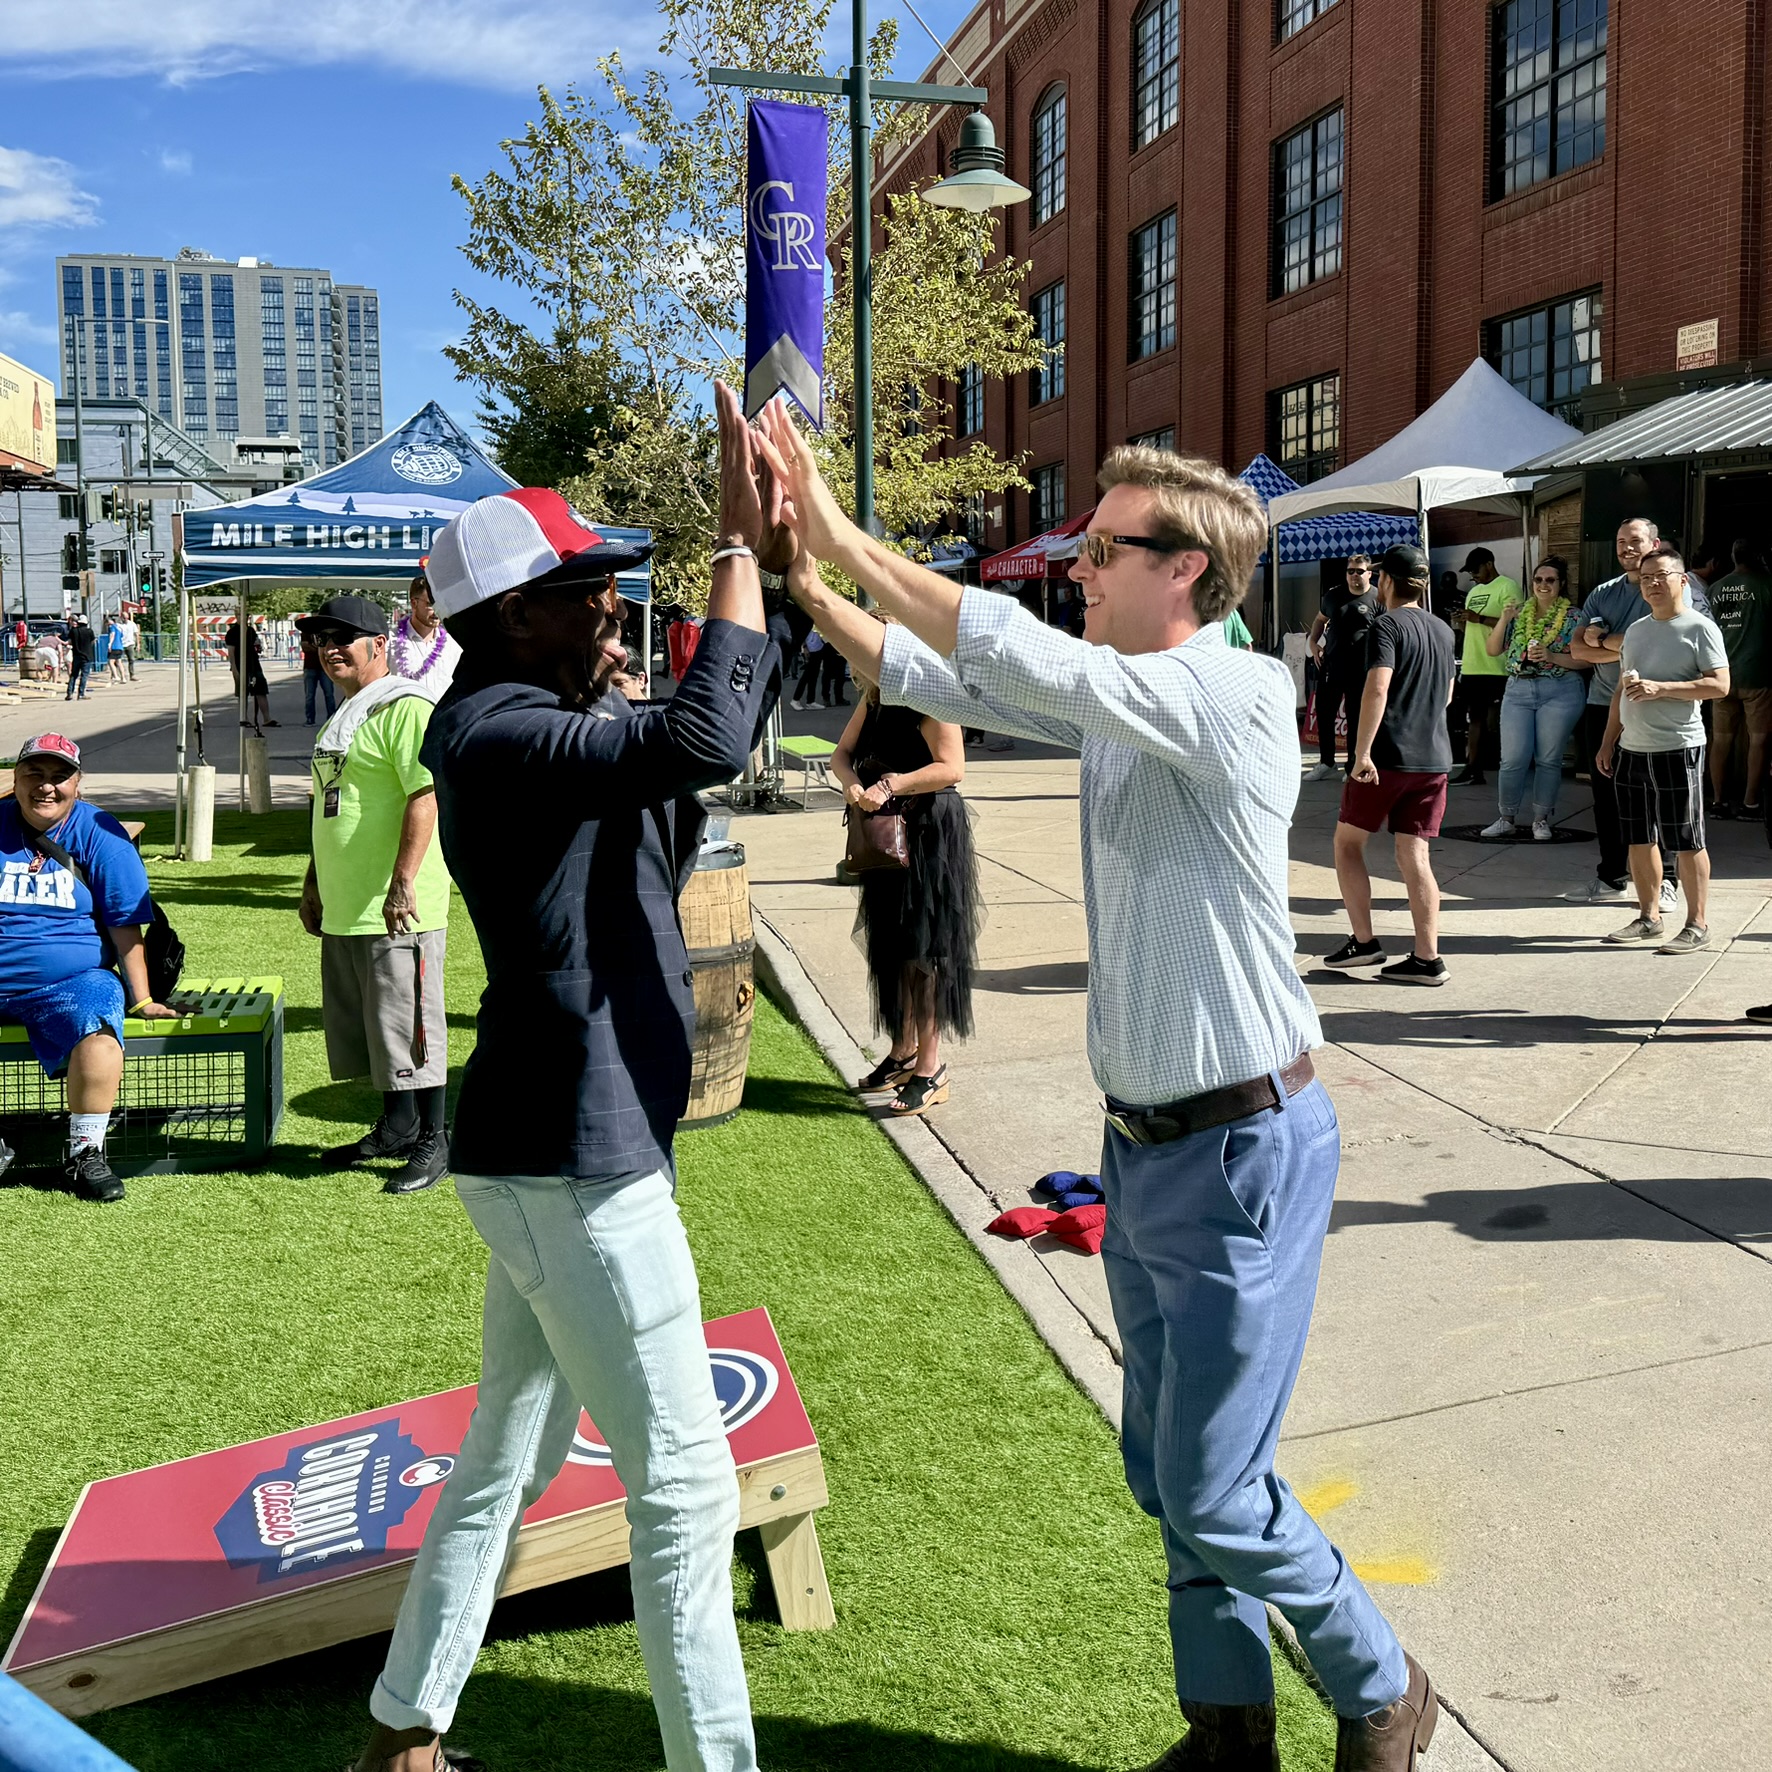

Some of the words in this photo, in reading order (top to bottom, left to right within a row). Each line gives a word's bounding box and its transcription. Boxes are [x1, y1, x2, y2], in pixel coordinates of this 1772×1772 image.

[1680, 330, 1687, 338] NO
[1691, 340, 1714, 352] PROPERTY
[1679, 353, 1704, 365] VIOLATORS
[1704, 350, 1716, 360] WILL
[211, 522, 295, 547] MILE
[306, 525, 391, 549] HIGH
[998, 558, 1038, 577] CHARACTER
[1721, 584, 1746, 593] MAKE
[1712, 591, 1756, 606] AMERICA
[0, 868, 76, 910] ALER
[367, 1454, 391, 1514] COLORADO
[277, 1432, 379, 1573] CORNHOLE
[255, 1481, 298, 1544] Classic
